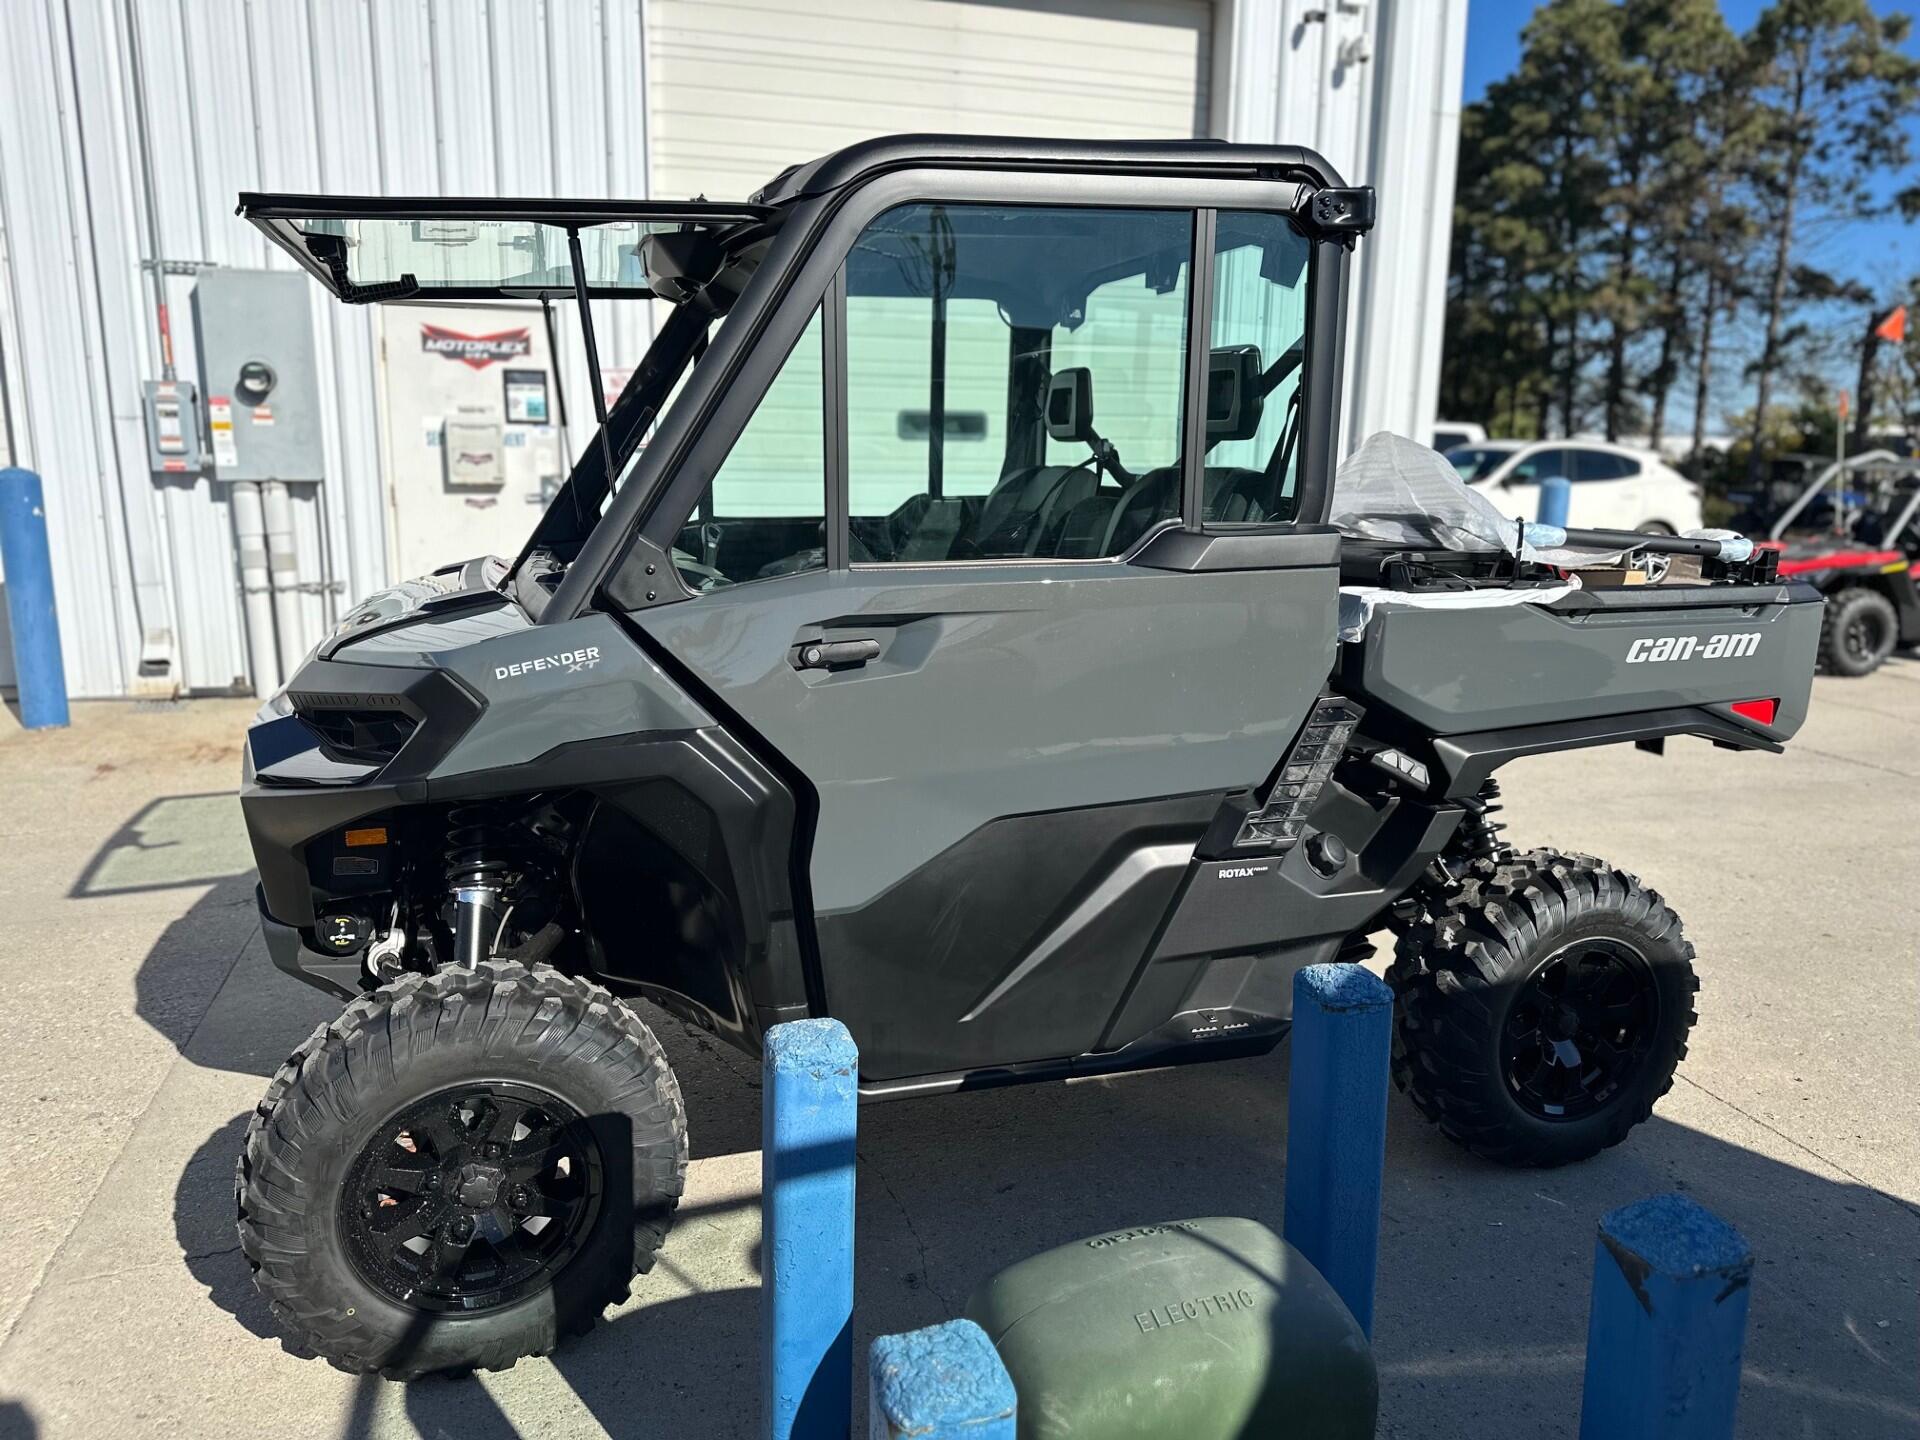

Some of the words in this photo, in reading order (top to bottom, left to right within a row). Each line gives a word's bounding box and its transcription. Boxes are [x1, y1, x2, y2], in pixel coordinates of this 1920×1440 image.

[425, 338, 527, 353] MOTOPLEX
[1625, 632, 1762, 663] can-am
[495, 646, 600, 680] DEFENDER
[567, 659, 600, 674] XT
[1218, 867, 1254, 878] ROTAX
[1134, 1288, 1256, 1333] ELECTRIC
